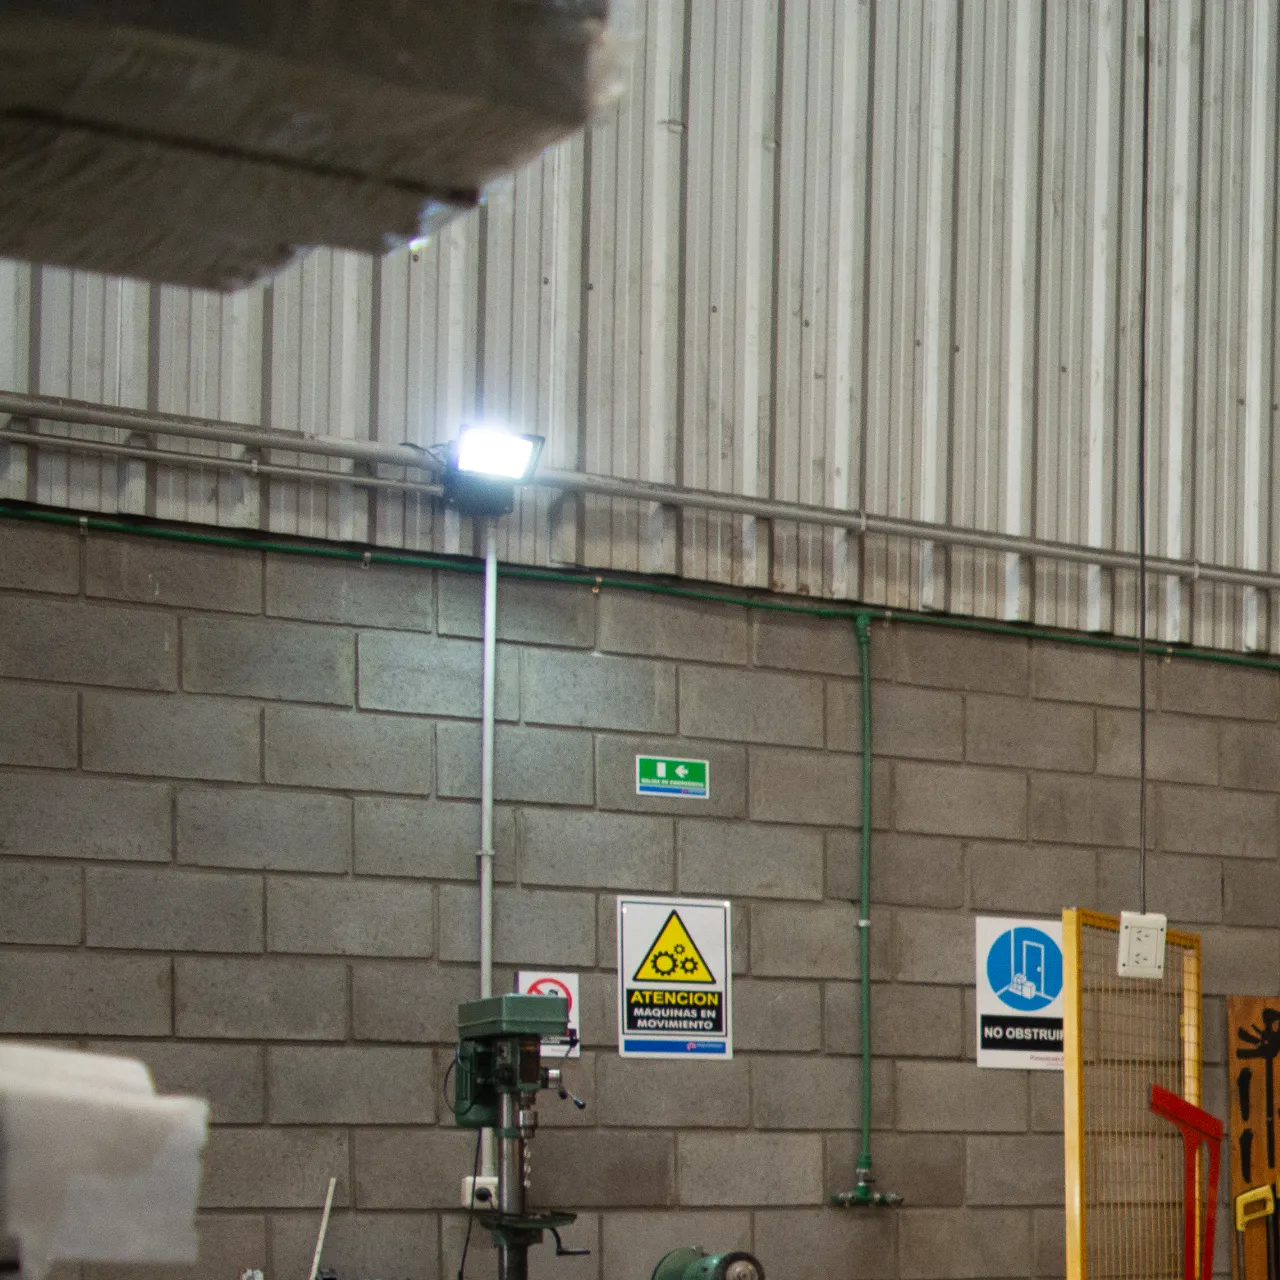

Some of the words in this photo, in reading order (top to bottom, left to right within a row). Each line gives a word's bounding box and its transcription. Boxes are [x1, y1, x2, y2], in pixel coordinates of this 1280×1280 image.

[630, 990, 719, 1006] ATENCION
[633, 1008, 698, 1018] MAQUINAS
[700, 1009, 716, 1018] EN
[637, 1020, 713, 1030] MOVIMIENTO
[984, 1026, 1003, 1039] NO
